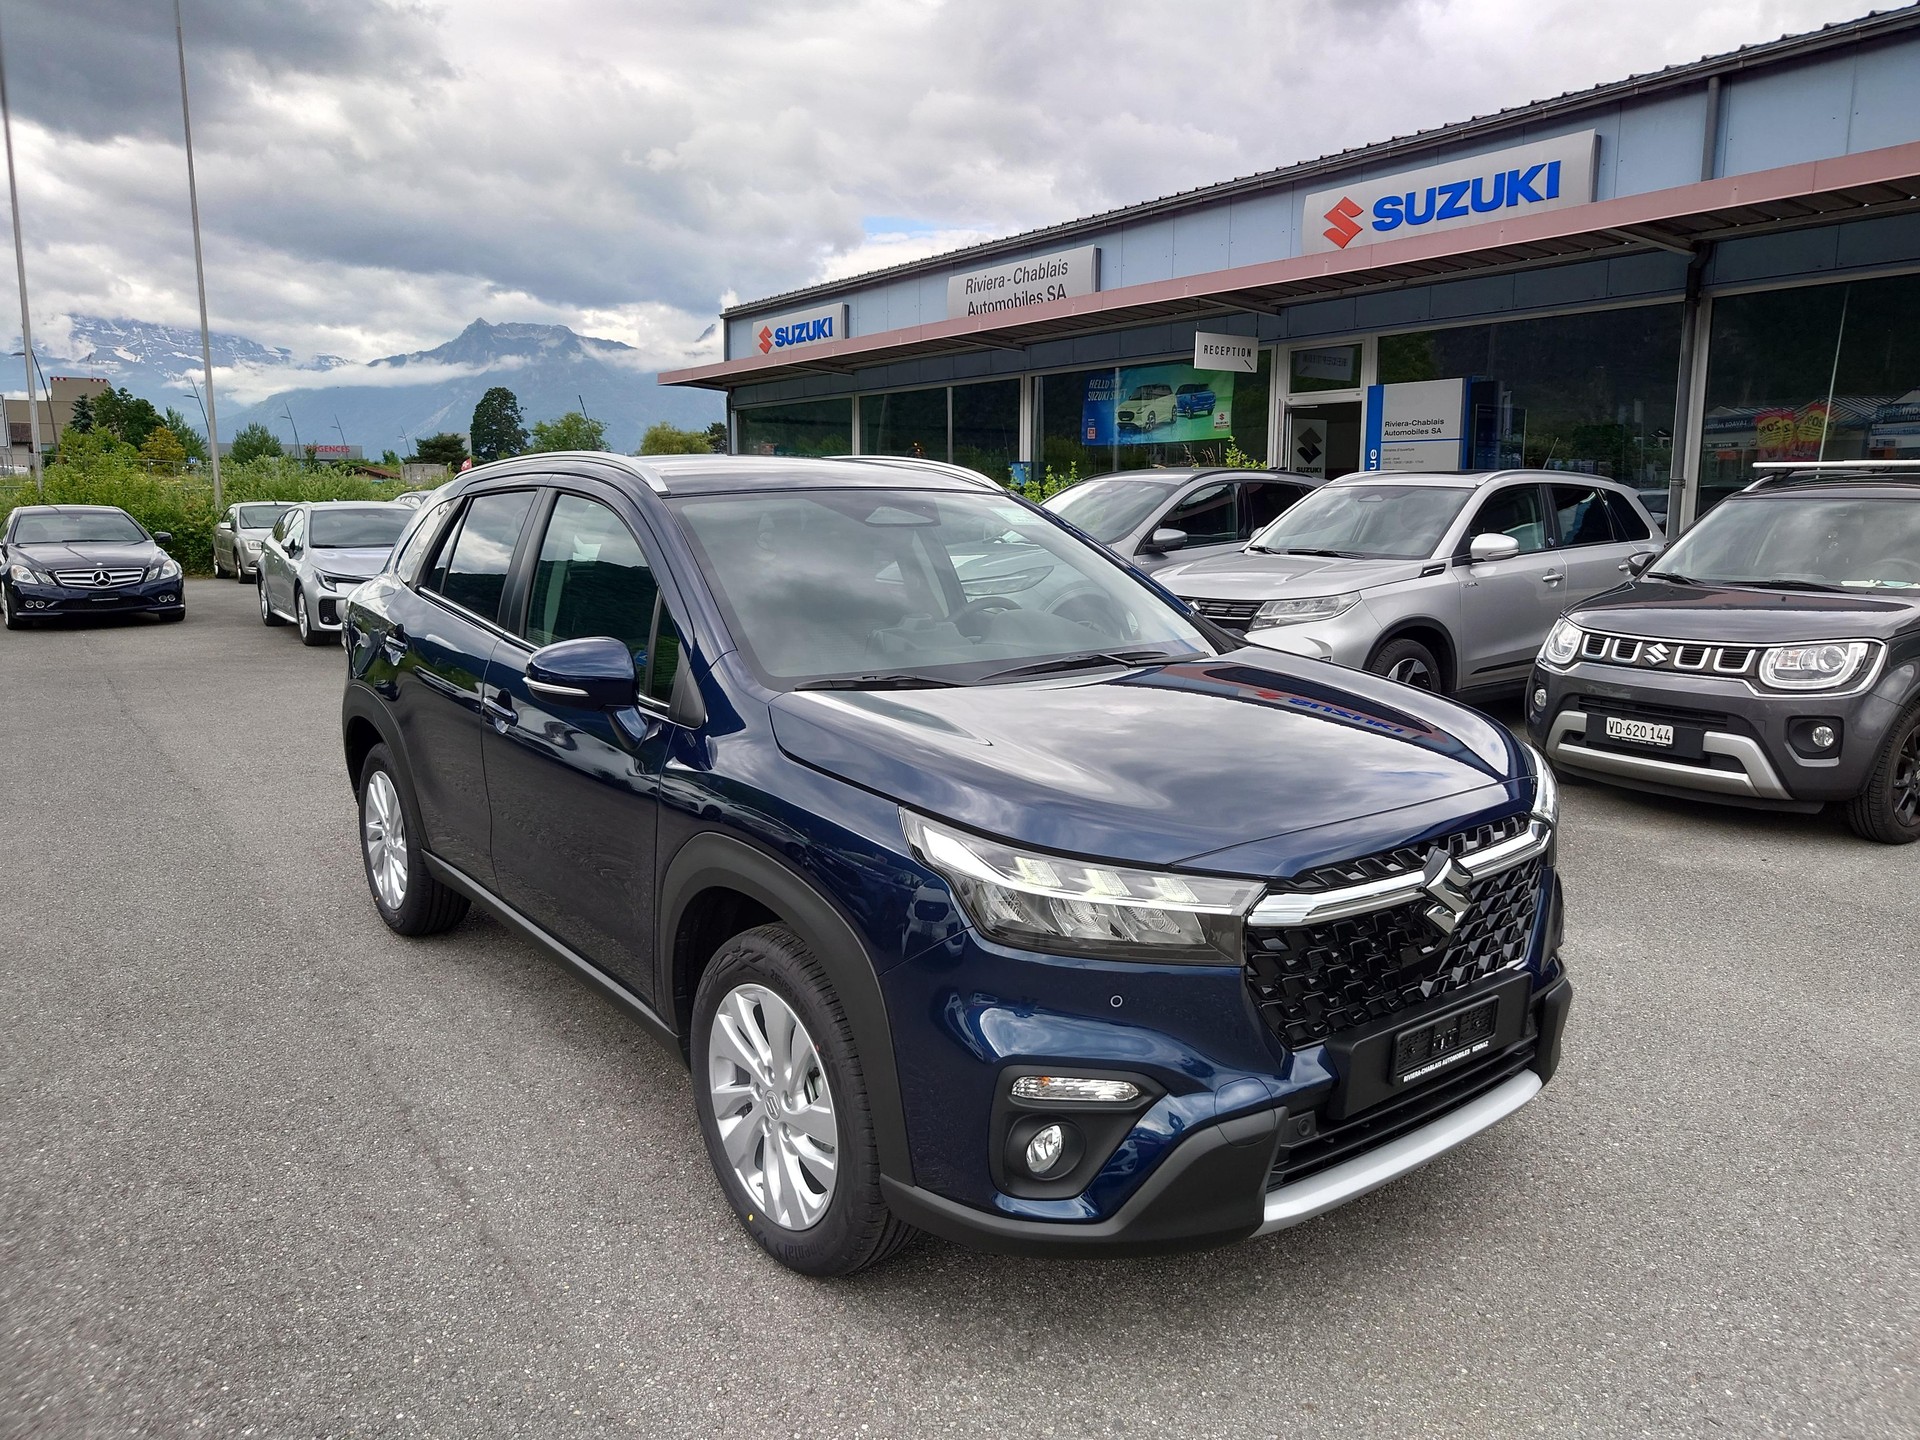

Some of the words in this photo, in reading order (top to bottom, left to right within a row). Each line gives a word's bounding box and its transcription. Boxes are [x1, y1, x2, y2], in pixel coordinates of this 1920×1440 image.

[1372, 160, 1561, 232] SUZUKI
[967, 290, 1044, 317] Automobiles
[1046, 283, 1067, 302] SA
[775, 317, 833, 347] SUZUKI
[1203, 344, 1252, 358] RECEPTION
[1088, 379, 1110, 389] HELLO
[1384, 418, 1445, 428] Riviera-Chablais
[1384, 428, 1429, 437] Automobiles
[1403, 1060, 1442, 1083] RIVIERA-CHABLAIS
[1442, 1048, 1470, 1066] AUTOMOBILES
